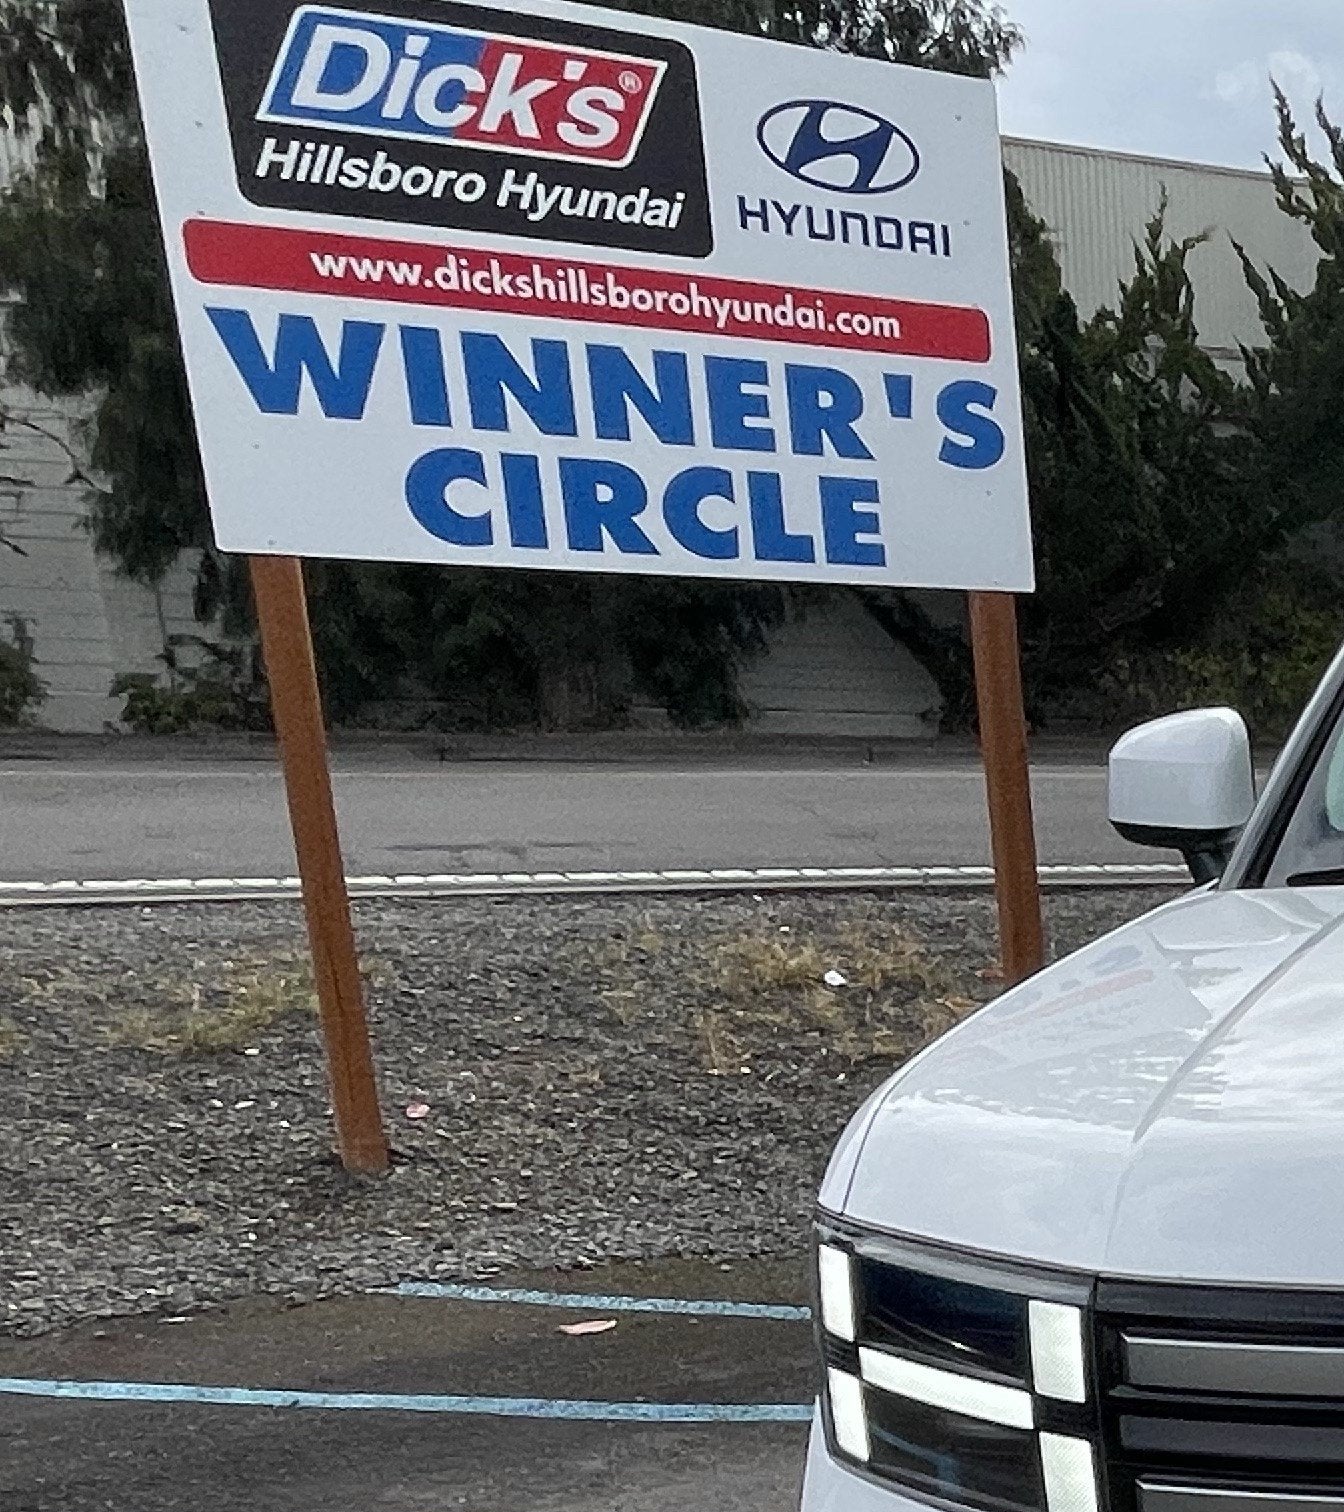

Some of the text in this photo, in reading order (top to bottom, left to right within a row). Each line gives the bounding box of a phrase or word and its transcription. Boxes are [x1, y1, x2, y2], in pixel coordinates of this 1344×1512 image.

[291, 24, 626, 148] Dick's
[255, 137, 686, 228] Hillsboro Hyundai
[736, 195, 951, 257] HYUNDAI
[309, 251, 901, 339] www.dickshillsborohyundai.com
[203, 304, 1006, 470] WINNER'S
[405, 447, 888, 568] CIRCLE
